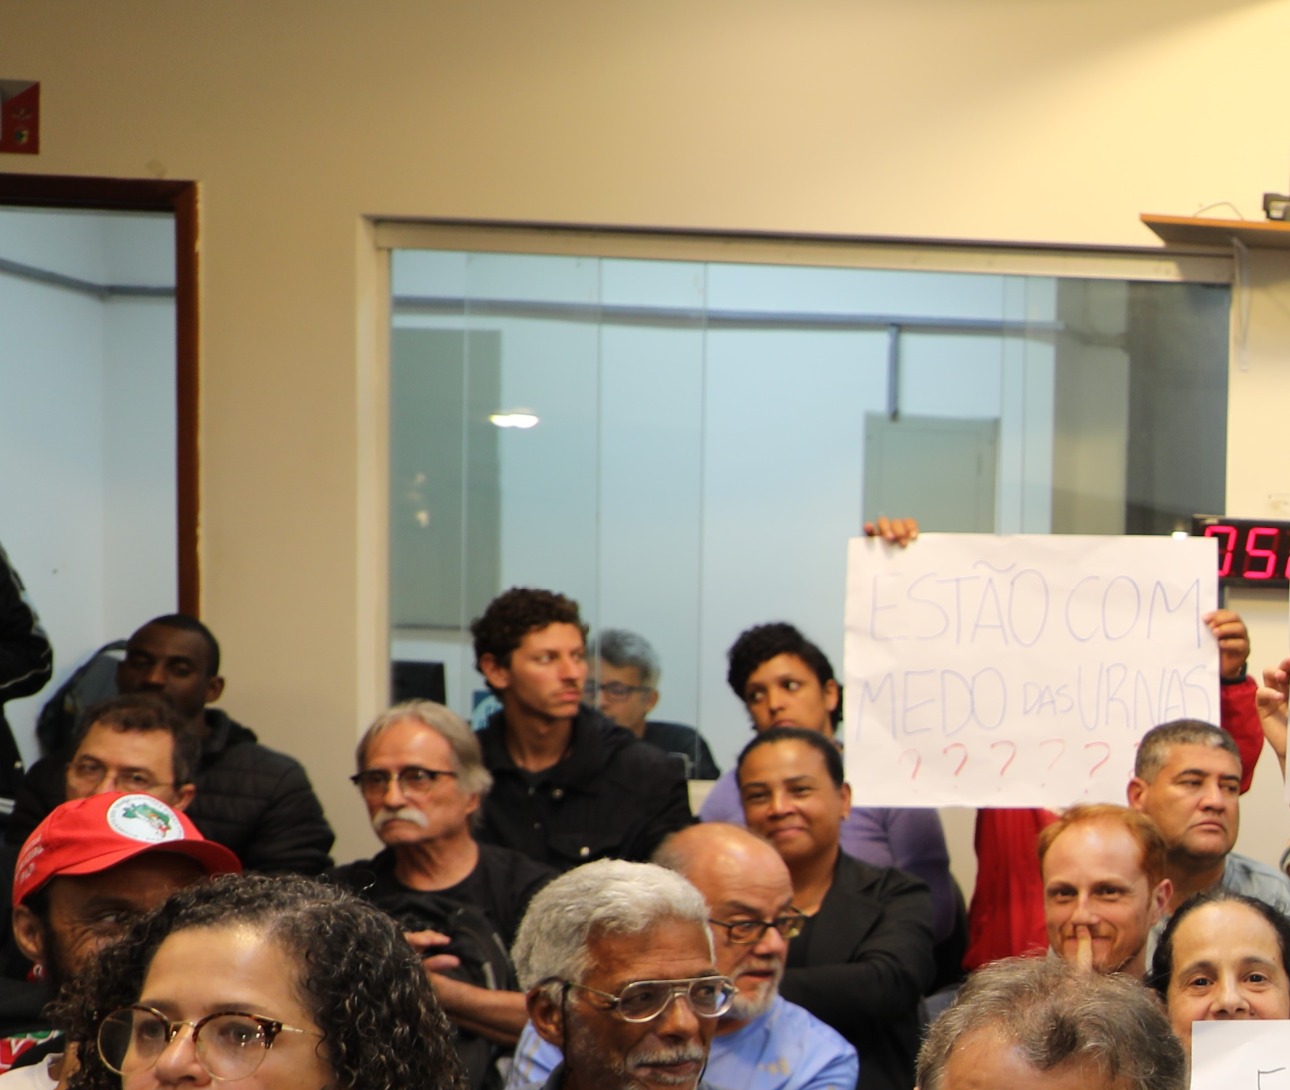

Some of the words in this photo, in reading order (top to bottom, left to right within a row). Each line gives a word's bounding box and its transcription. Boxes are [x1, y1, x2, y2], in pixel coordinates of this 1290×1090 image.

[868, 558, 1051, 648] ESTÃO
[1065, 574, 1203, 649] COM
[856, 665, 1008, 742] MEDO
[1022, 681, 1076, 715] DAS
[1077, 661, 1212, 731] URNAS
